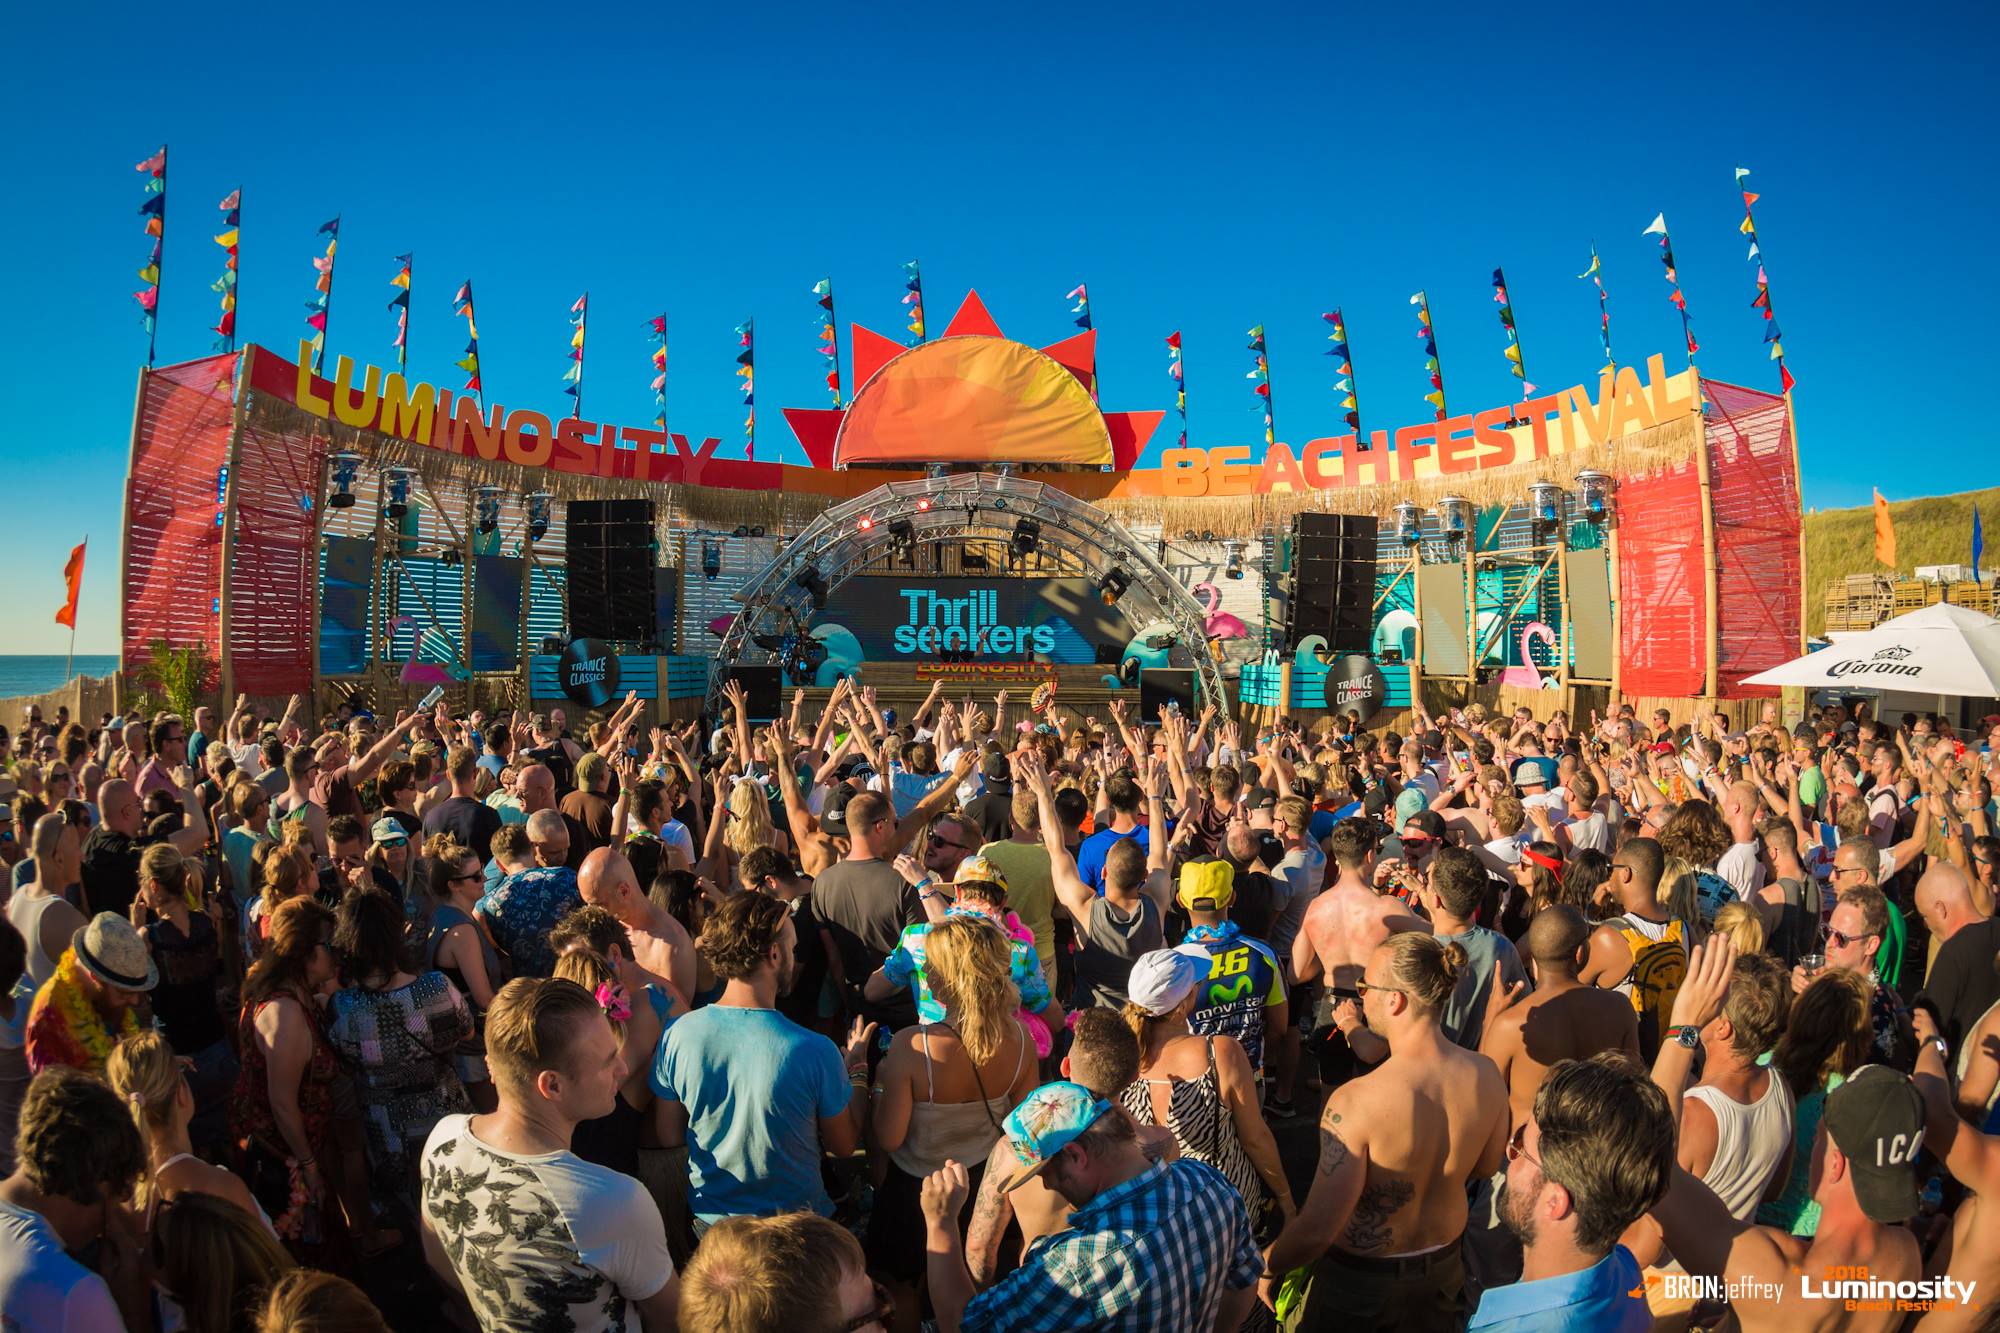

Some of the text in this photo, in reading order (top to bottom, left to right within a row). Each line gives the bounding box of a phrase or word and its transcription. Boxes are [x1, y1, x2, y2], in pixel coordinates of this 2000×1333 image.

[296, 337, 722, 485] LUMINOSITY
[899, 589, 998, 626] Thrill
[893, 624, 1056, 654] seekers
[570, 656, 607, 672] TRANCE
[917, 661, 1055, 673] LUMINOSITY
[1826, 659, 1923, 679] Corona
[570, 672, 606, 686] CLASSICS
[915, 672, 977, 682] Beach
[1336, 674, 1373, 690] TRANCE
[1336, 690, 1373, 705] CLASSICS
[1208, 946, 1250, 980] 46
[1195, 994, 1265, 1020] movistar
